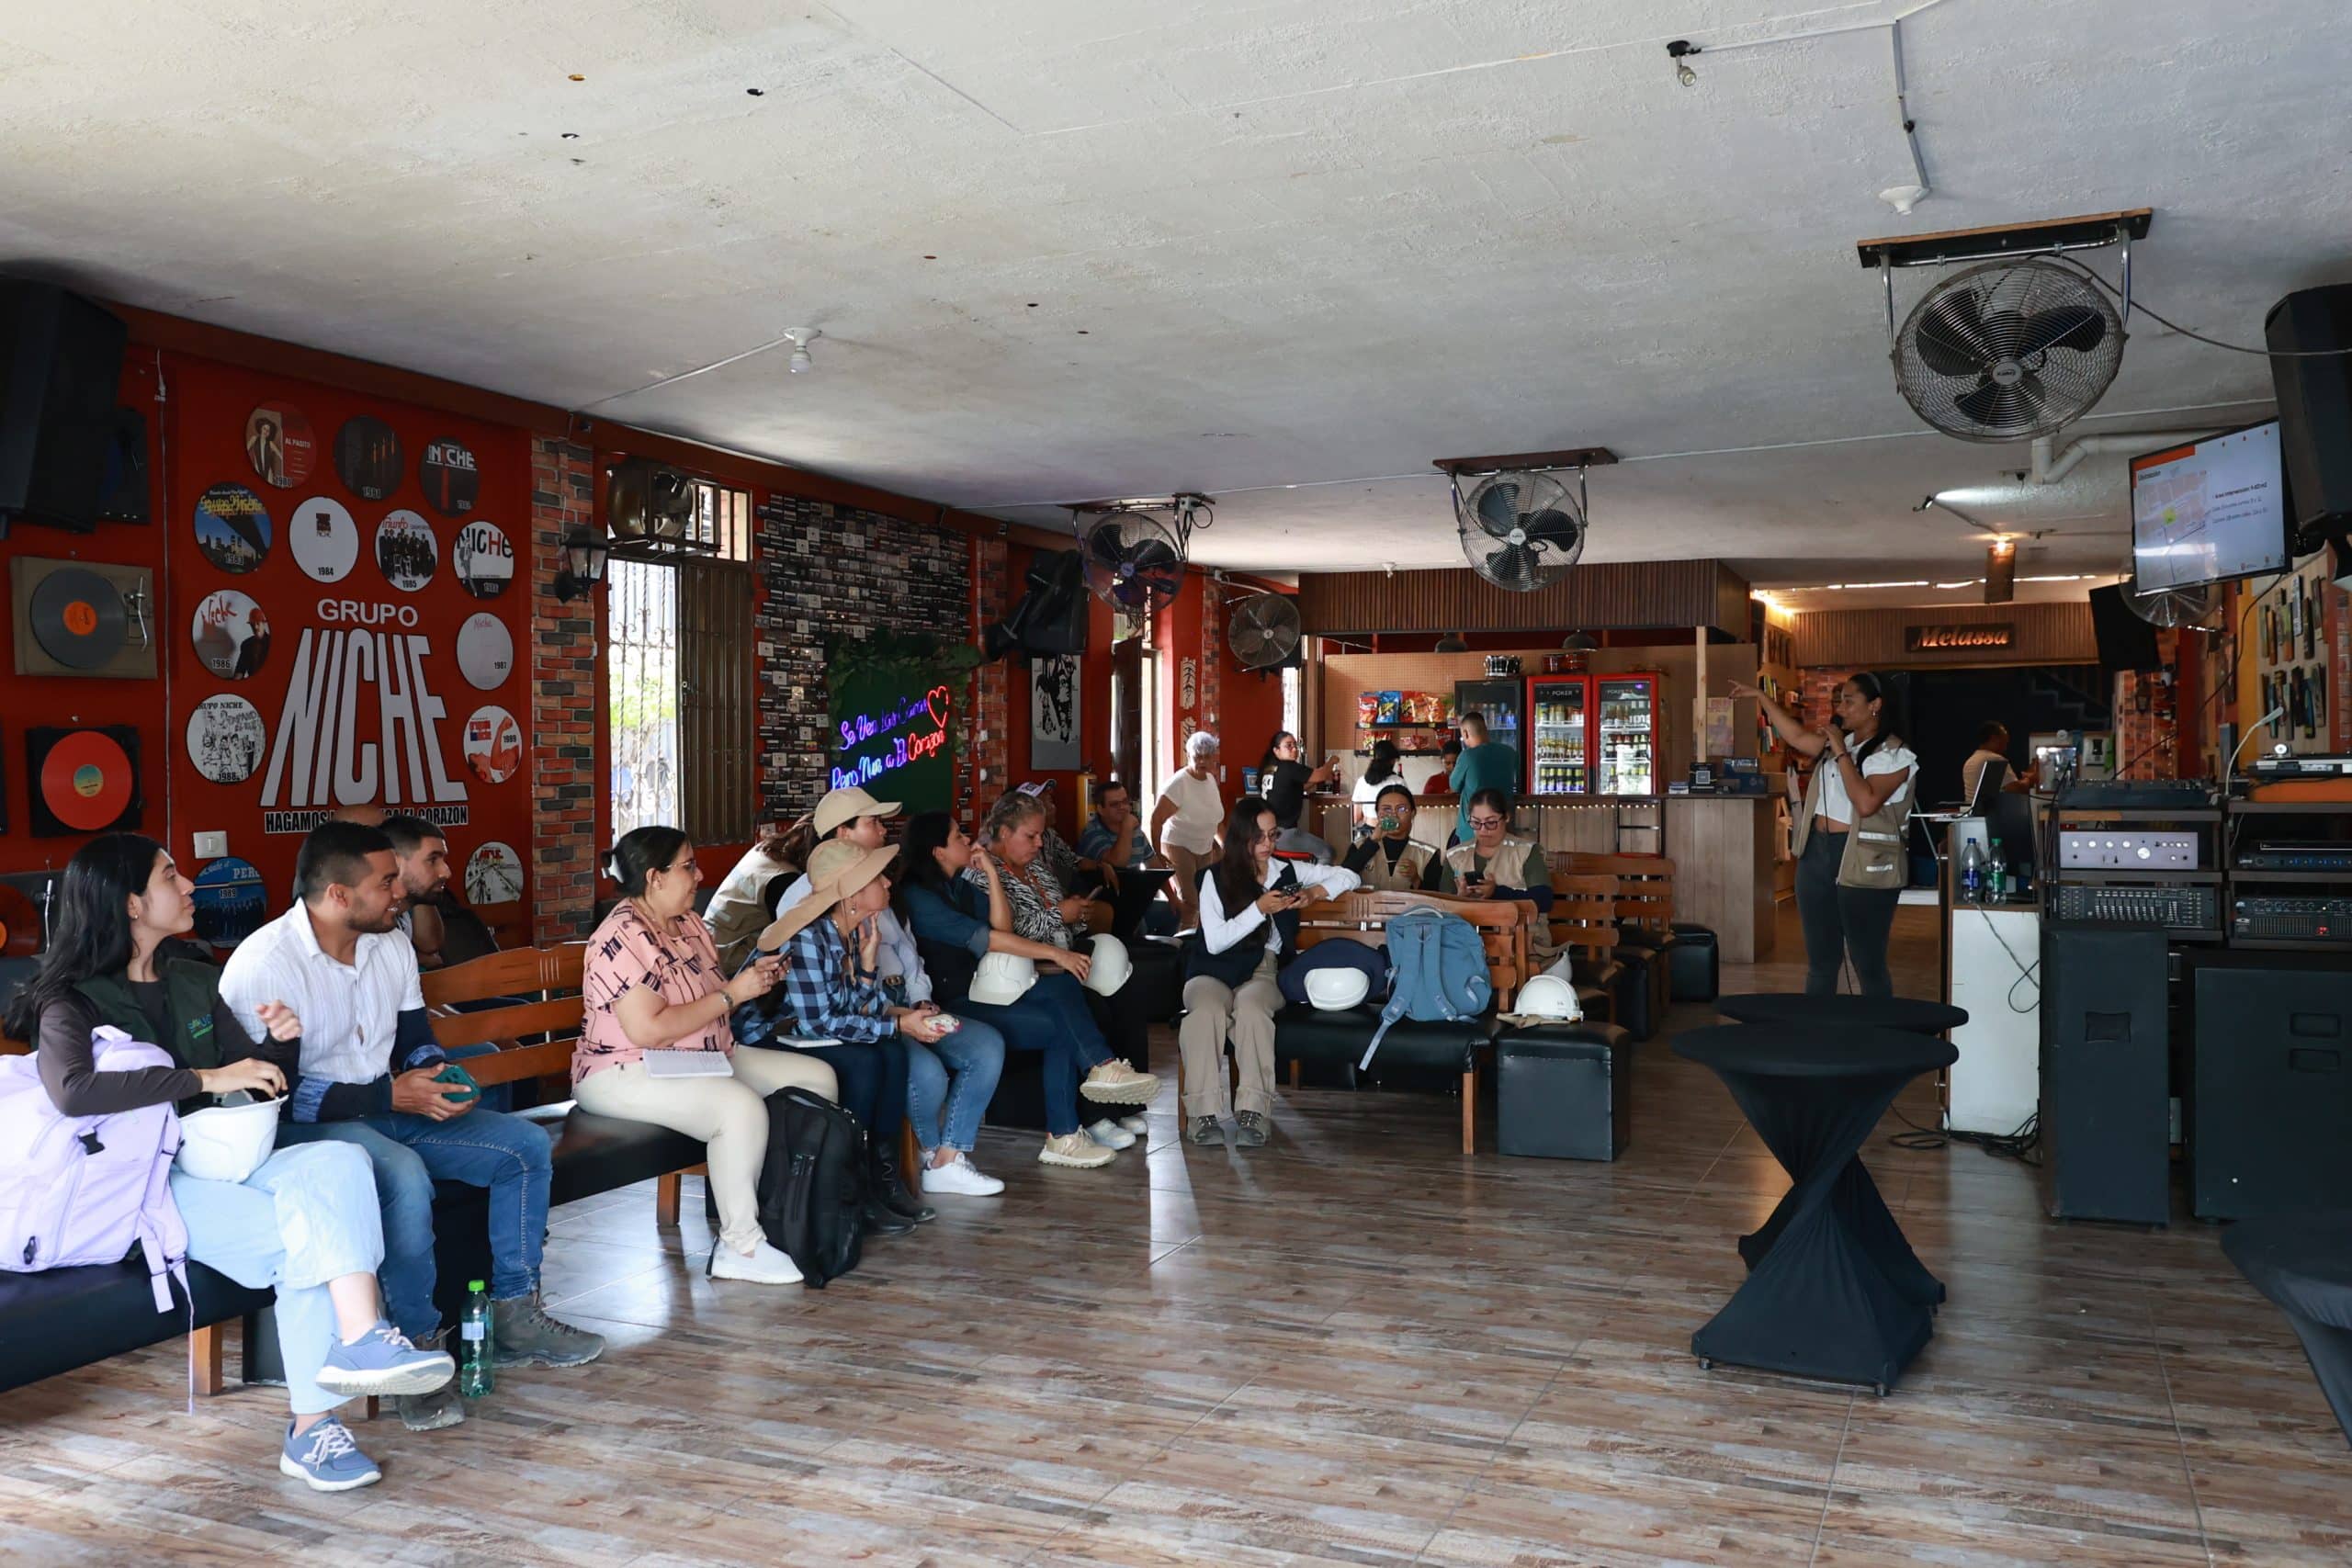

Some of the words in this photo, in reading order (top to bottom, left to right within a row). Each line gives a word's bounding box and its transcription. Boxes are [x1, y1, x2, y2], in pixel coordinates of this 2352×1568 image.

[318, 567, 334, 575] 1984
[317, 599, 419, 627] GRUPO
[212, 658, 231, 669] 1986
[259, 627, 469, 807] NICHE
[840, 720, 856, 750] Se
[855, 714, 878, 741] Ven
[831, 766, 859, 790] Pero
[266, 811, 328, 832] HAGAMOS
